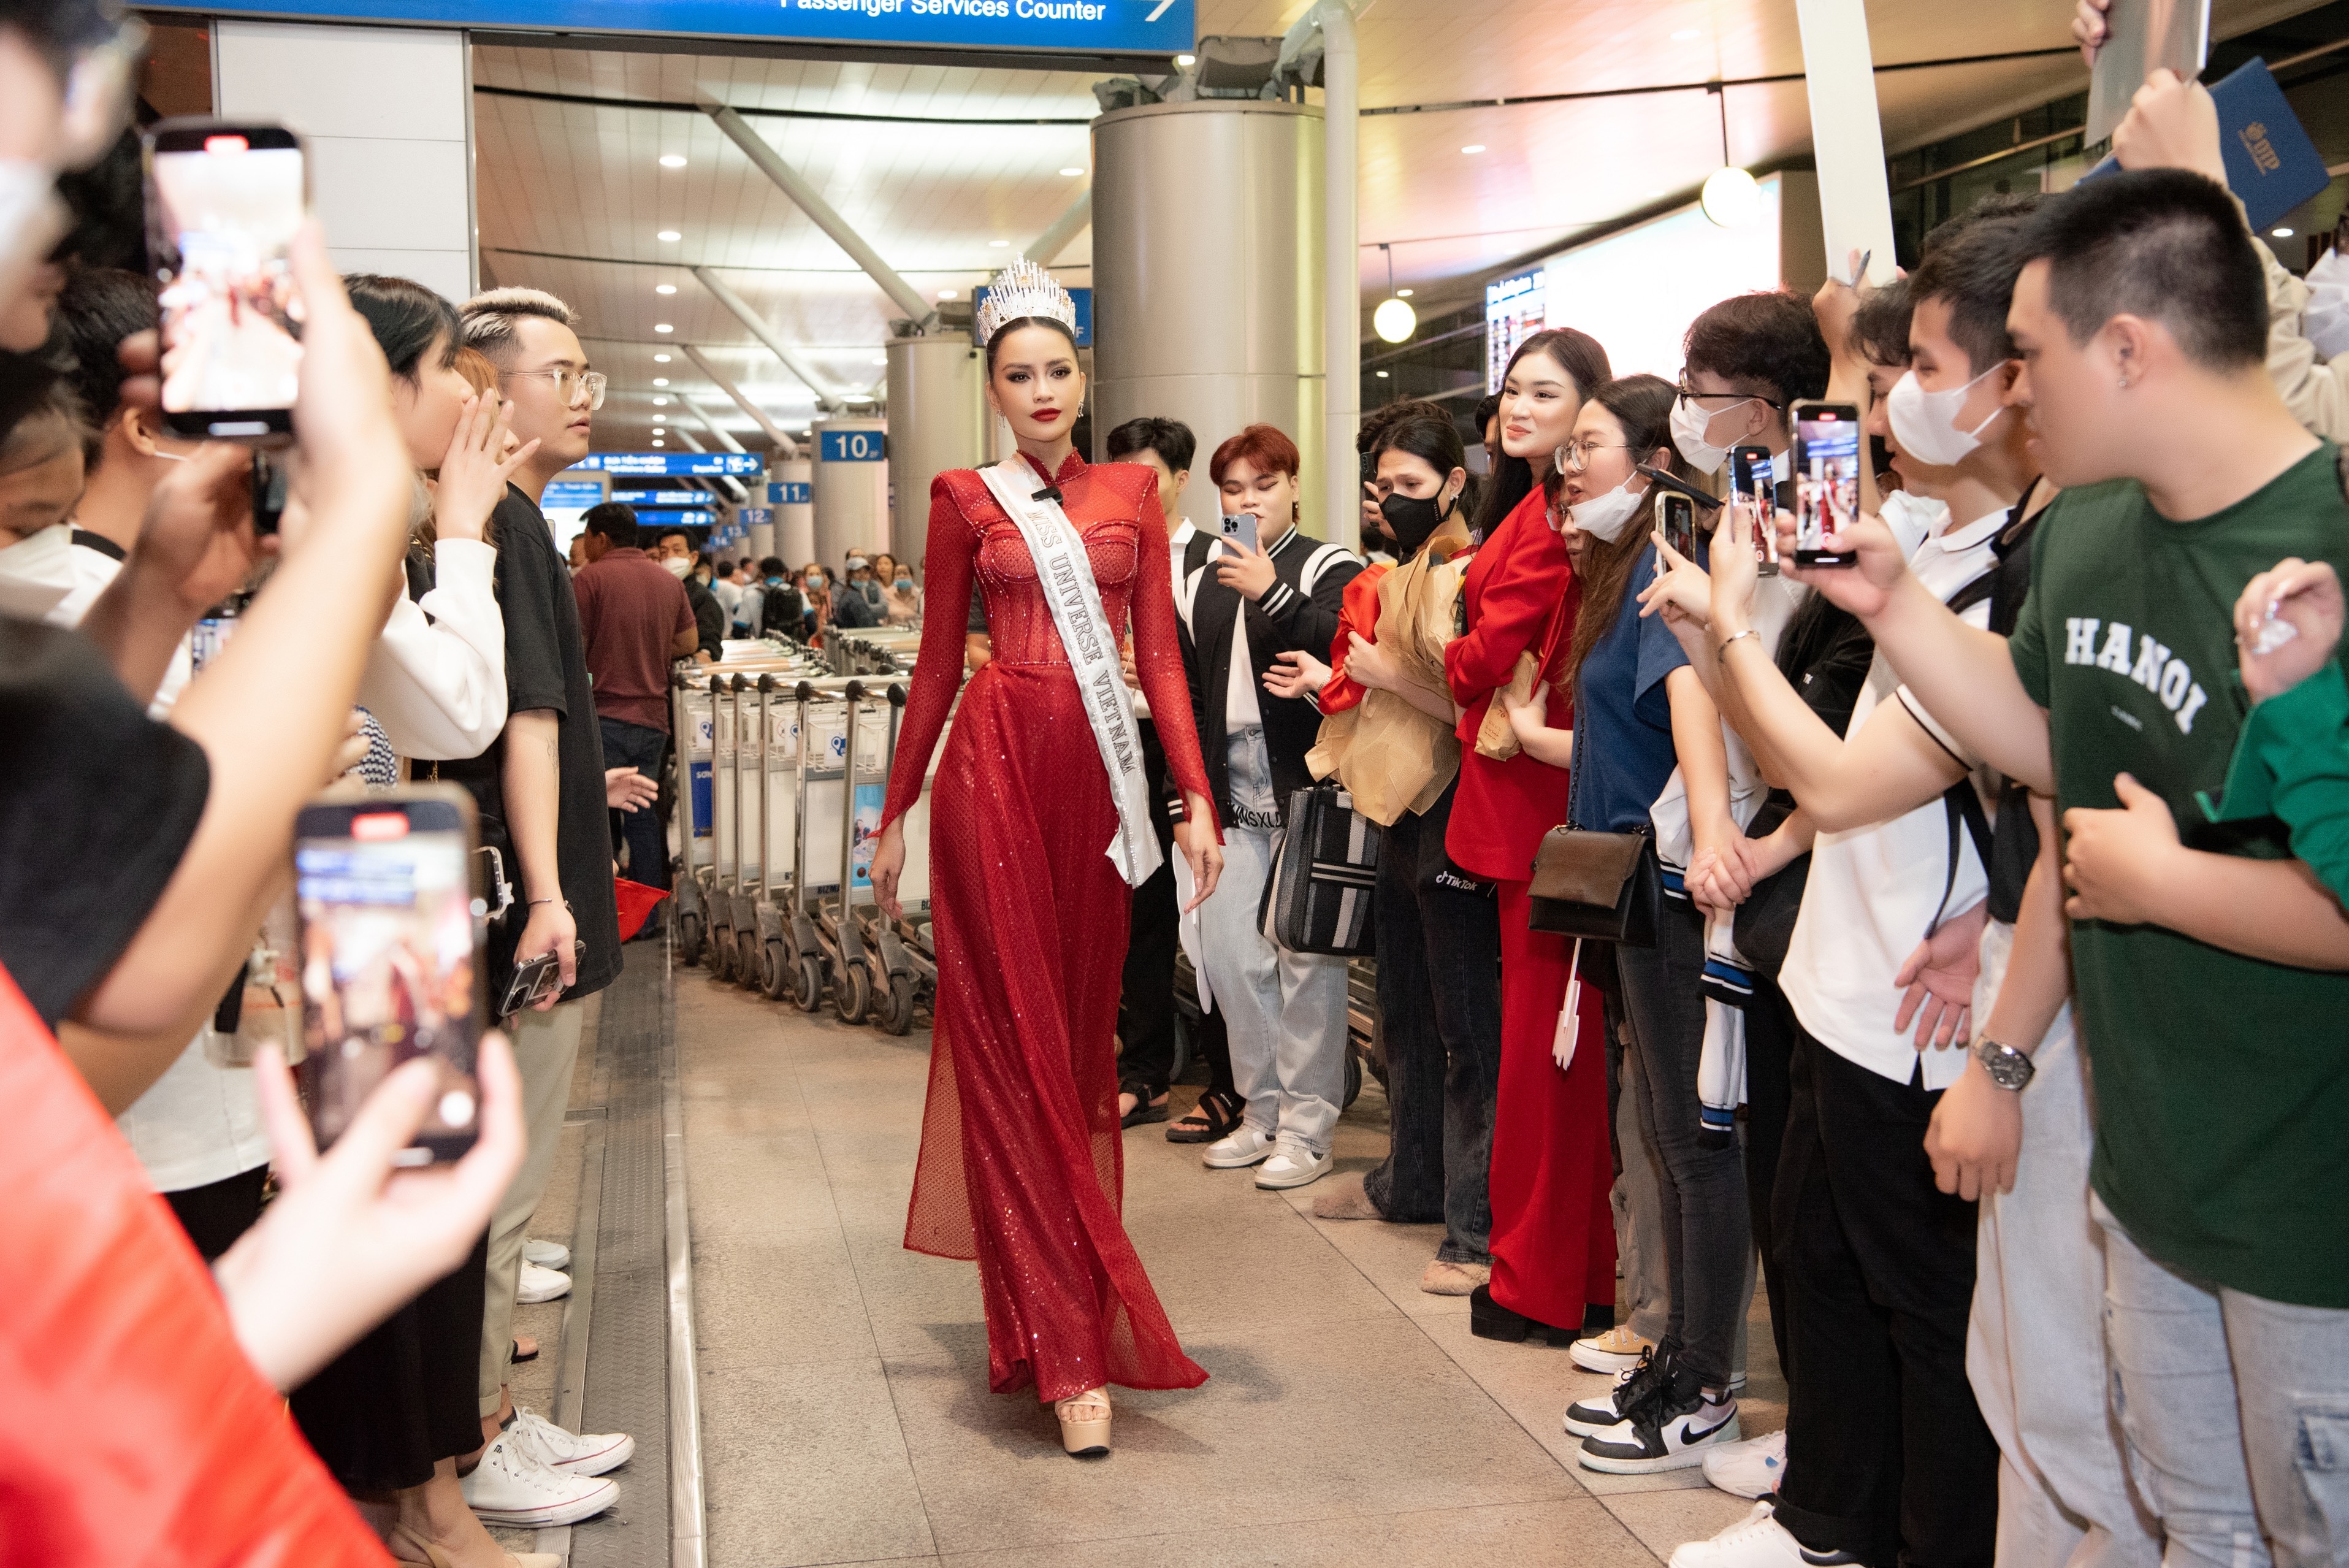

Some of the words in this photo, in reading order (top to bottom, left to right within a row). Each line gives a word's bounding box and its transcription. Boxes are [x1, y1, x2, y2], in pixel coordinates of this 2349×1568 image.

[911, 0, 1009, 17] Services
[1015, 0, 1106, 20] Counter
[836, 434, 868, 459] 10
[779, 484, 800, 502] 11
[747, 509, 765, 523] 12
[1025, 510, 1063, 548] MISS
[1049, 552, 1104, 666] UNIVERSE
[1093, 670, 1136, 777] VIETNAM
[2064, 617, 2208, 735] HANOI
[1446, 874, 1478, 891] TikTok
